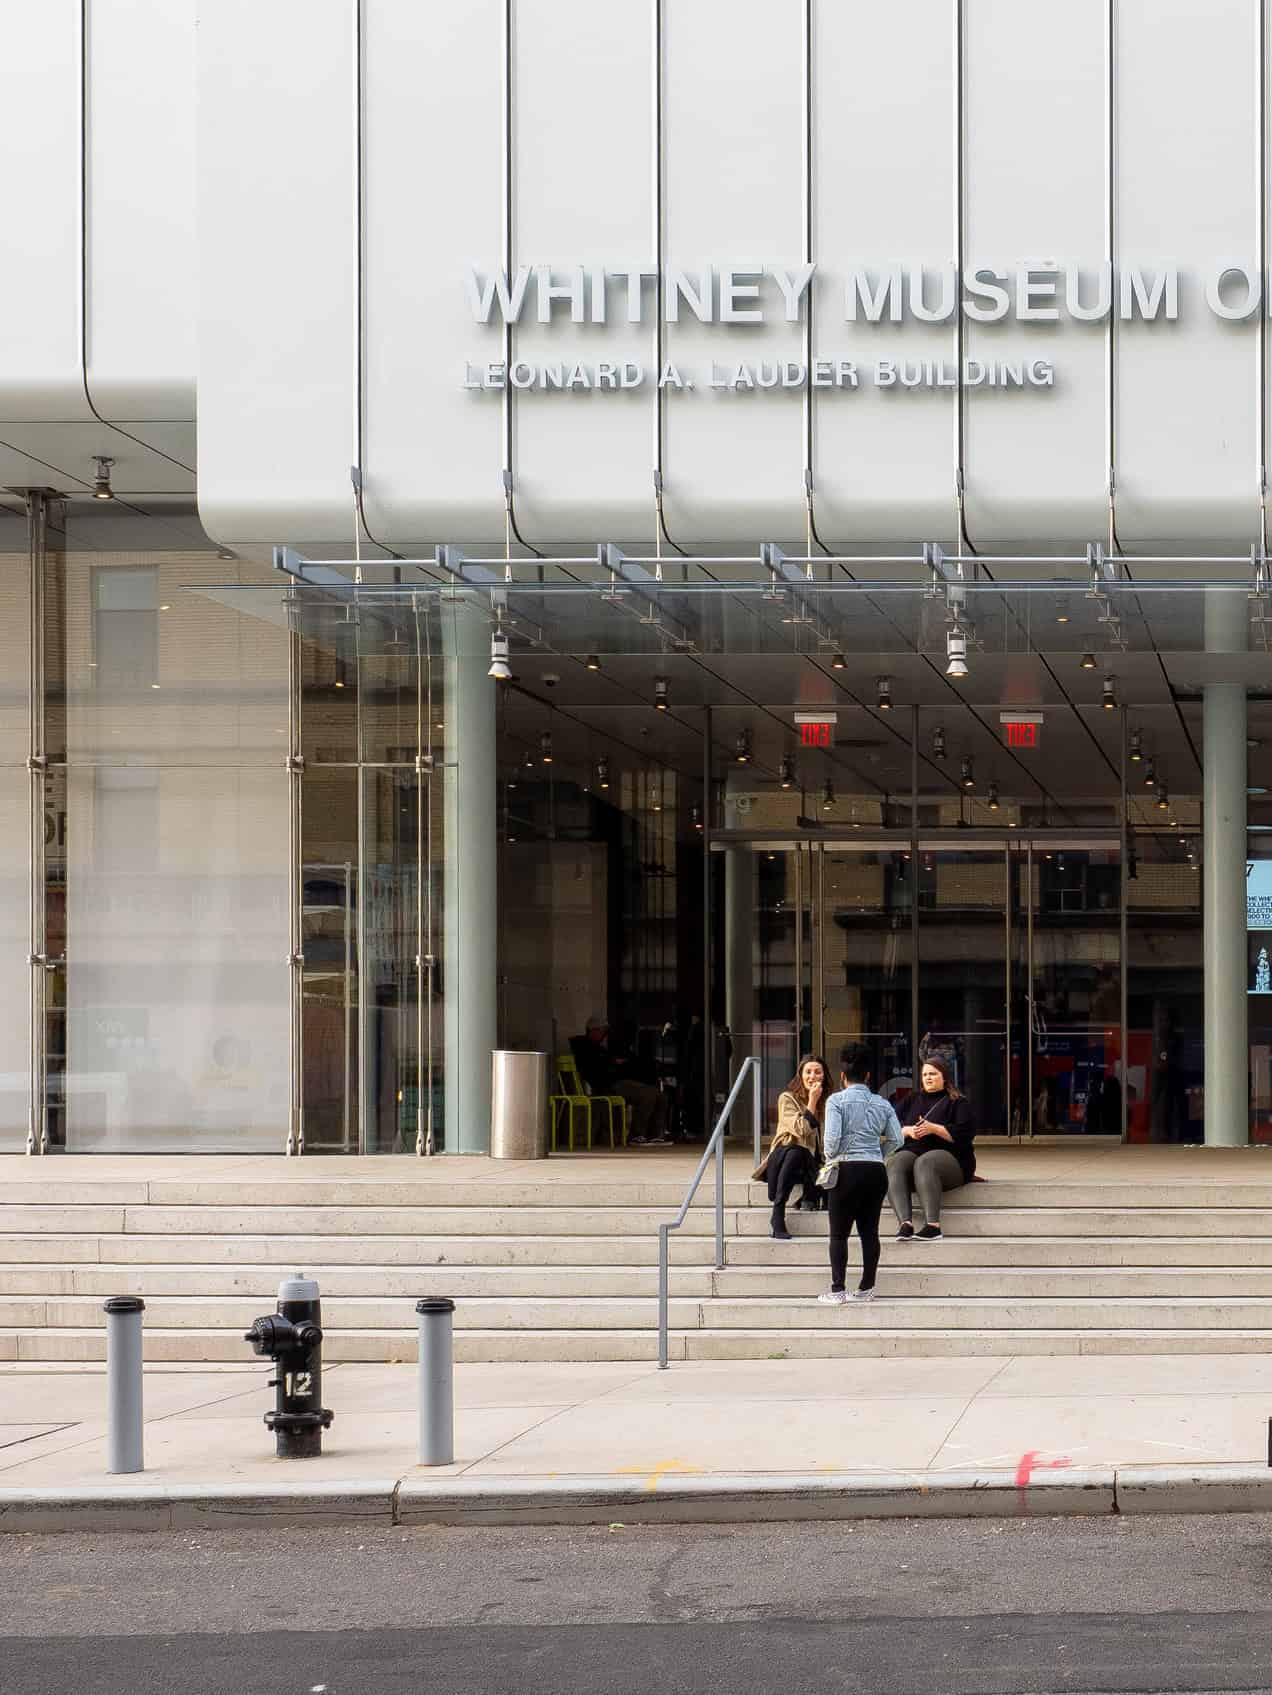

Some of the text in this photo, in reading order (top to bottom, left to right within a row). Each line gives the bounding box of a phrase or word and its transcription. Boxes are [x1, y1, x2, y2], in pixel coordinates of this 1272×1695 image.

[467, 262, 818, 324] WHITNEY
[845, 261, 1178, 323] MUSEUM
[464, 358, 1056, 390] LEONARD A. LAUDER BUILDING
[285, 1371, 313, 1397] 12
